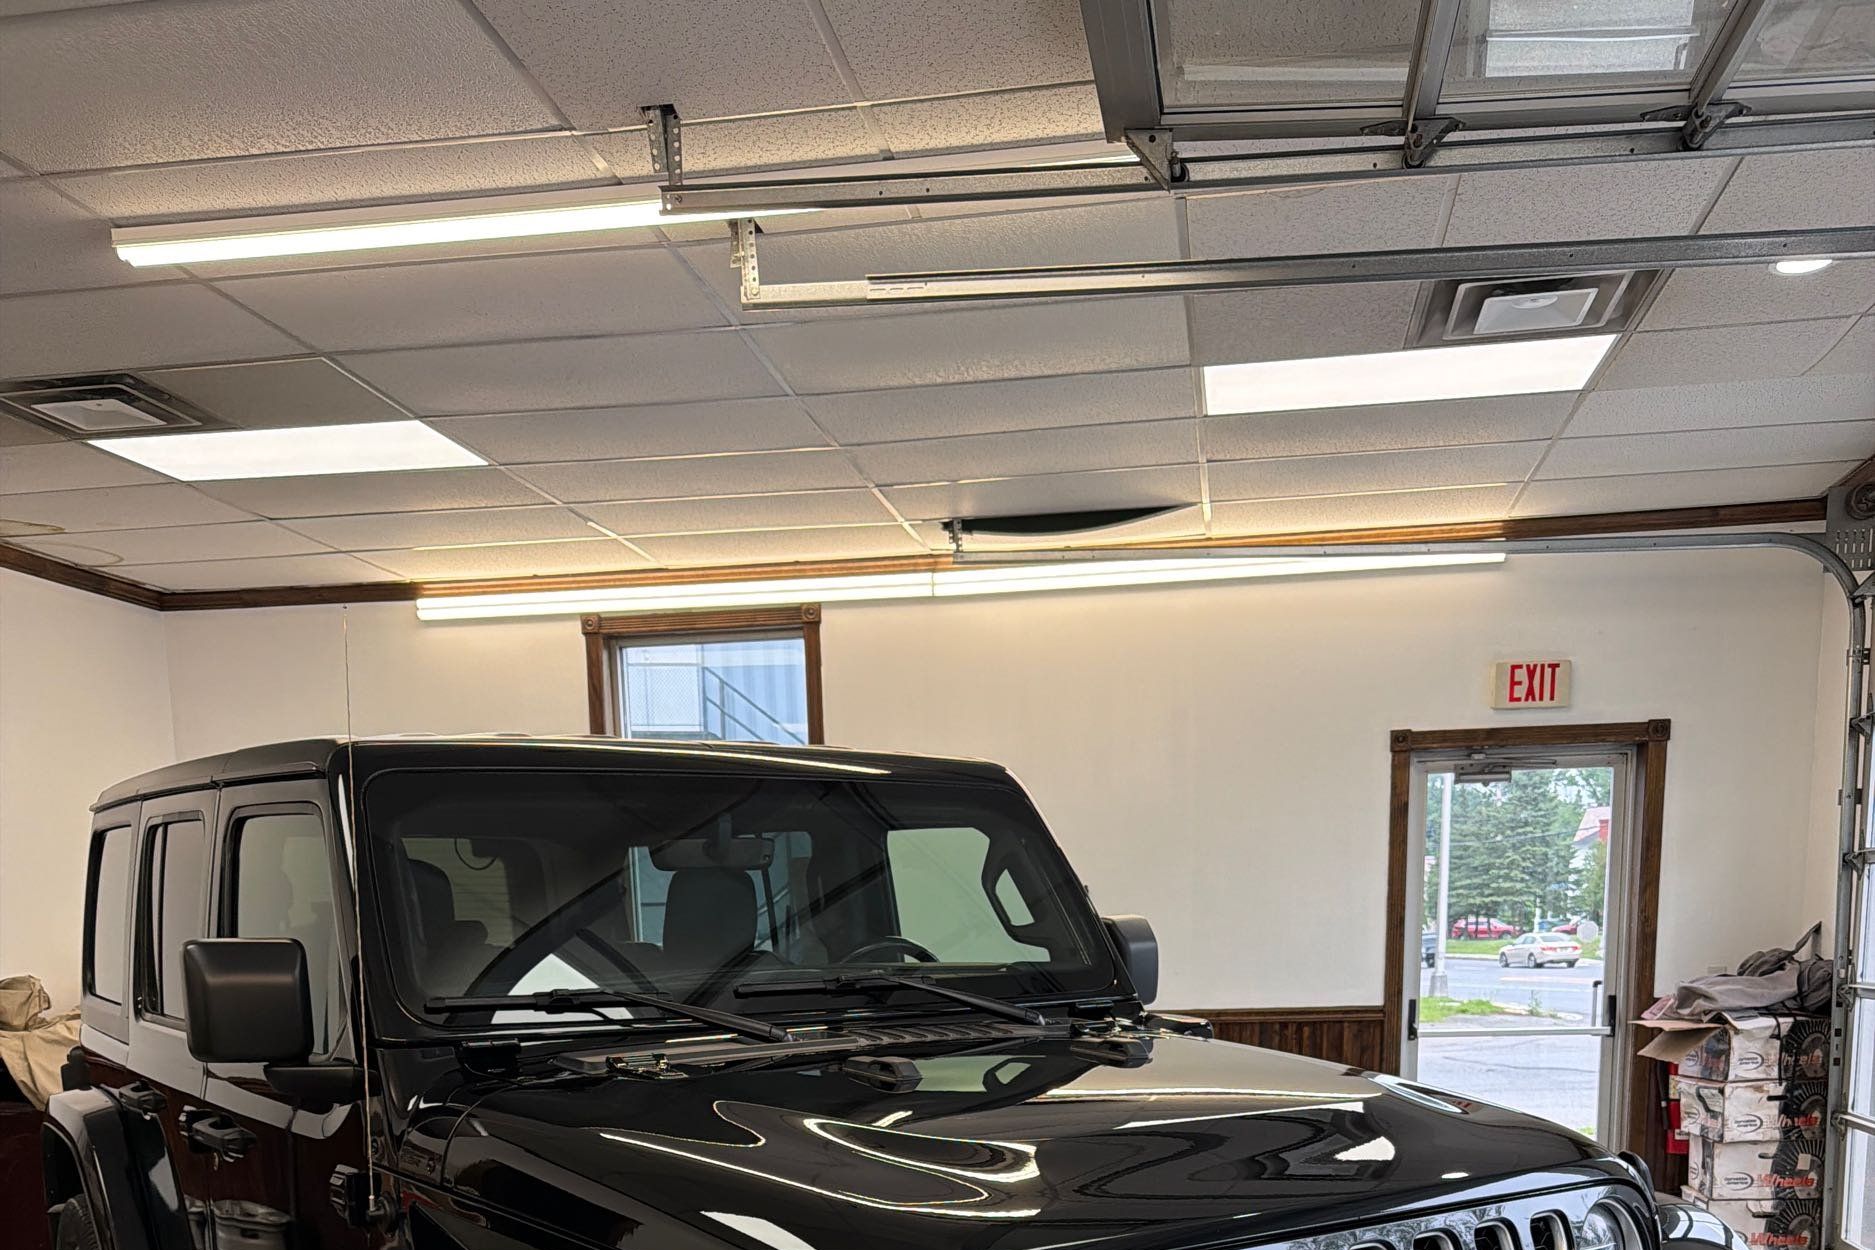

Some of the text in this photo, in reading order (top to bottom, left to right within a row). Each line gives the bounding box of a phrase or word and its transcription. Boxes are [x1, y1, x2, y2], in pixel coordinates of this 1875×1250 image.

[1508, 663, 1560, 702] EXIT
[1759, 1173, 1815, 1188] Wheels
[1750, 1232, 1808, 1246] Wheels
